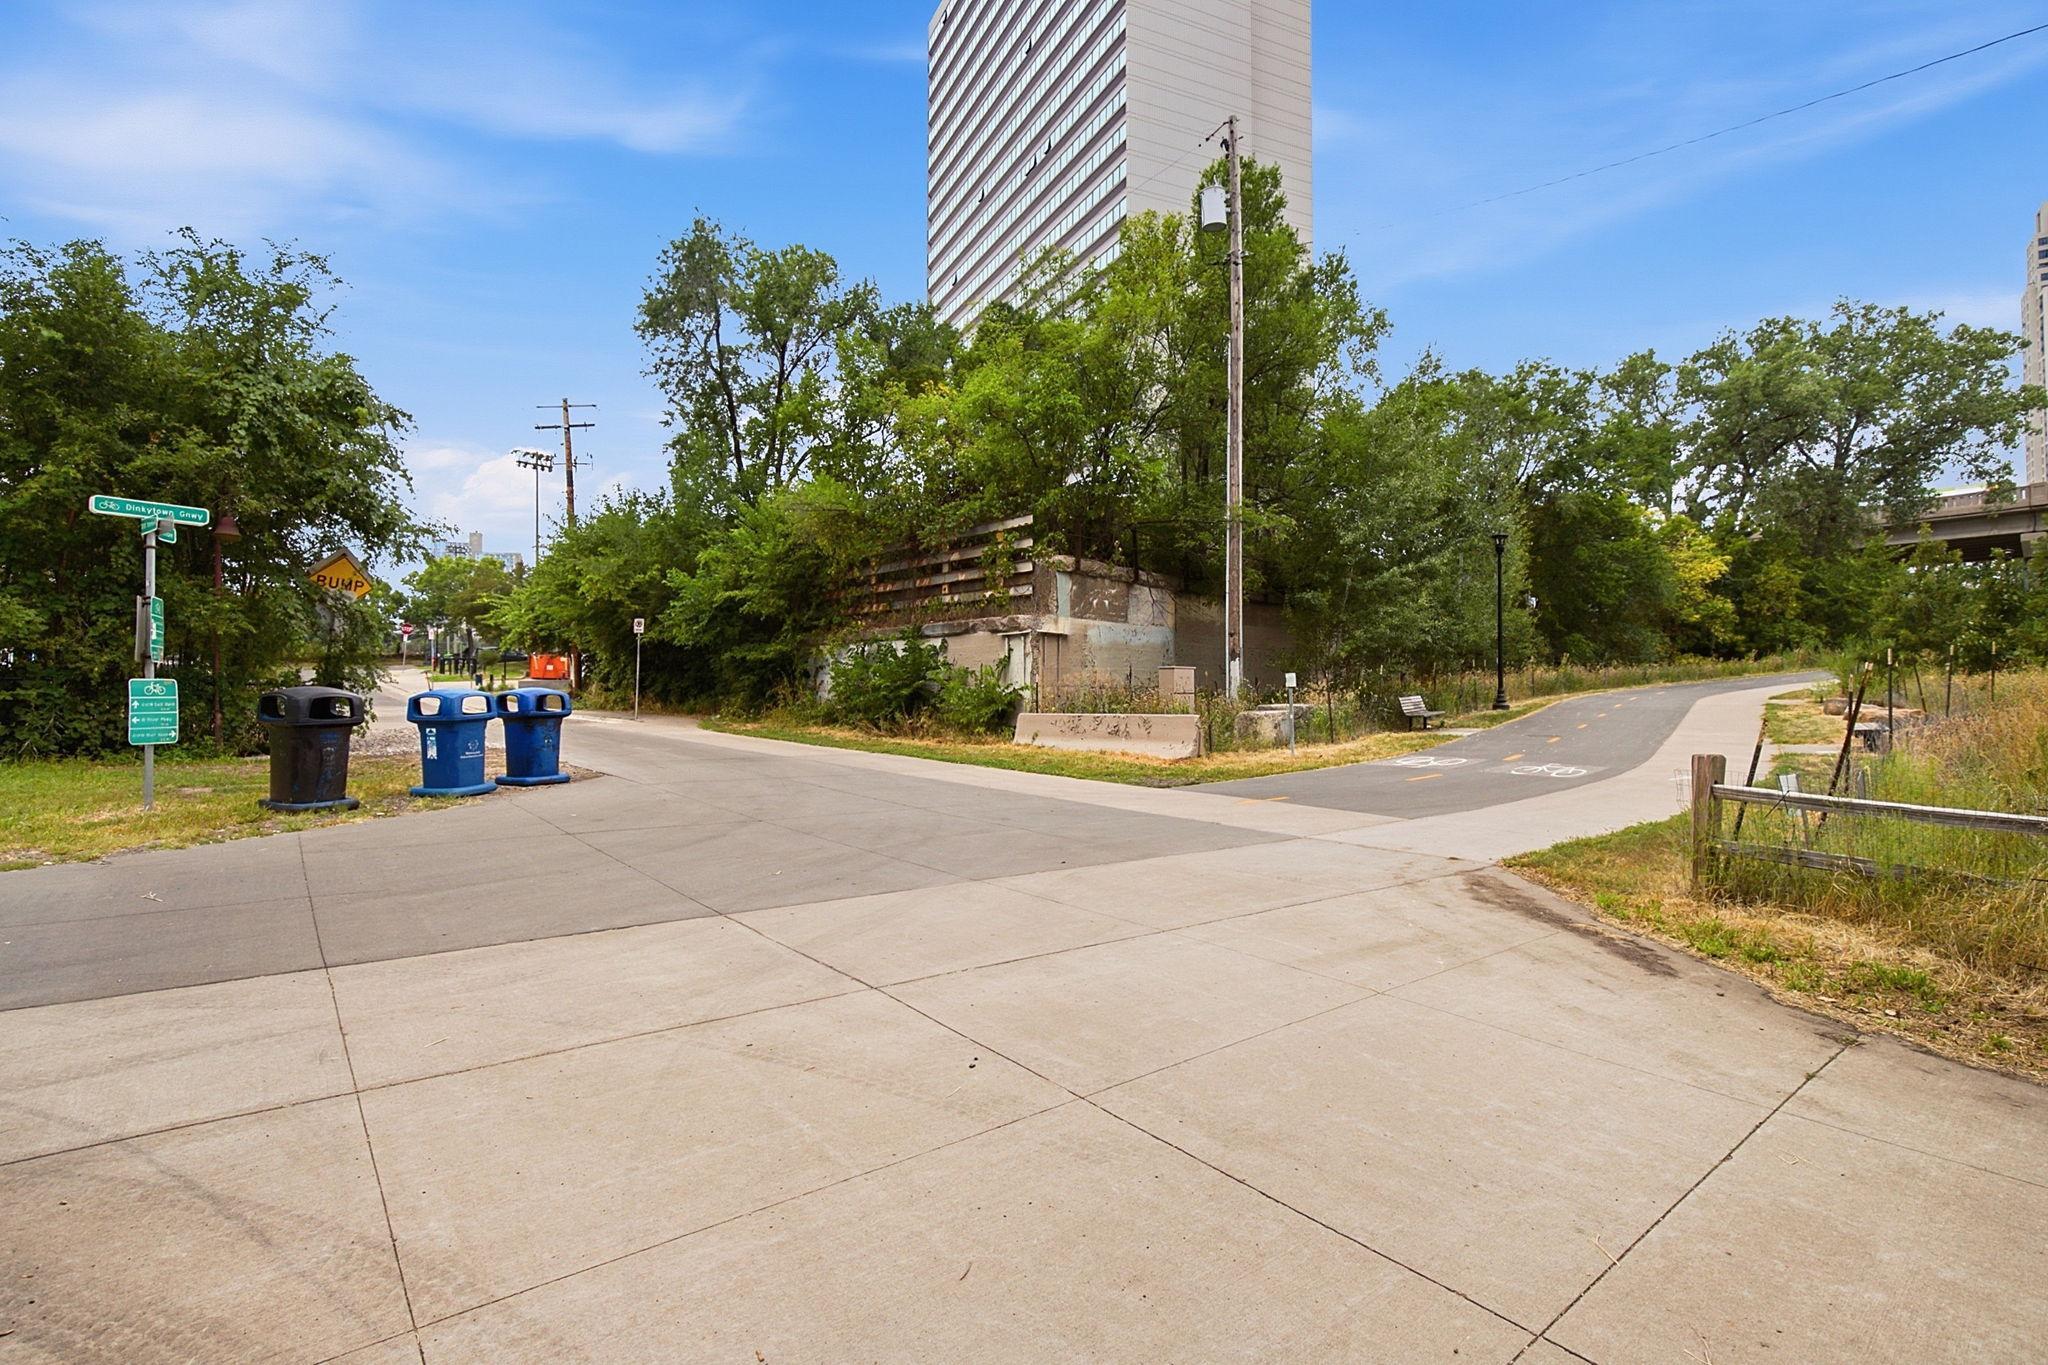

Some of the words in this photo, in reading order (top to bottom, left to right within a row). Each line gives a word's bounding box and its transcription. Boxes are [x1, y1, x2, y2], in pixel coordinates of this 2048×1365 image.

[125, 503, 174, 517] Dinkytown
[179, 511, 204, 521] Gnwy
[316, 574, 365, 592] BUMP
